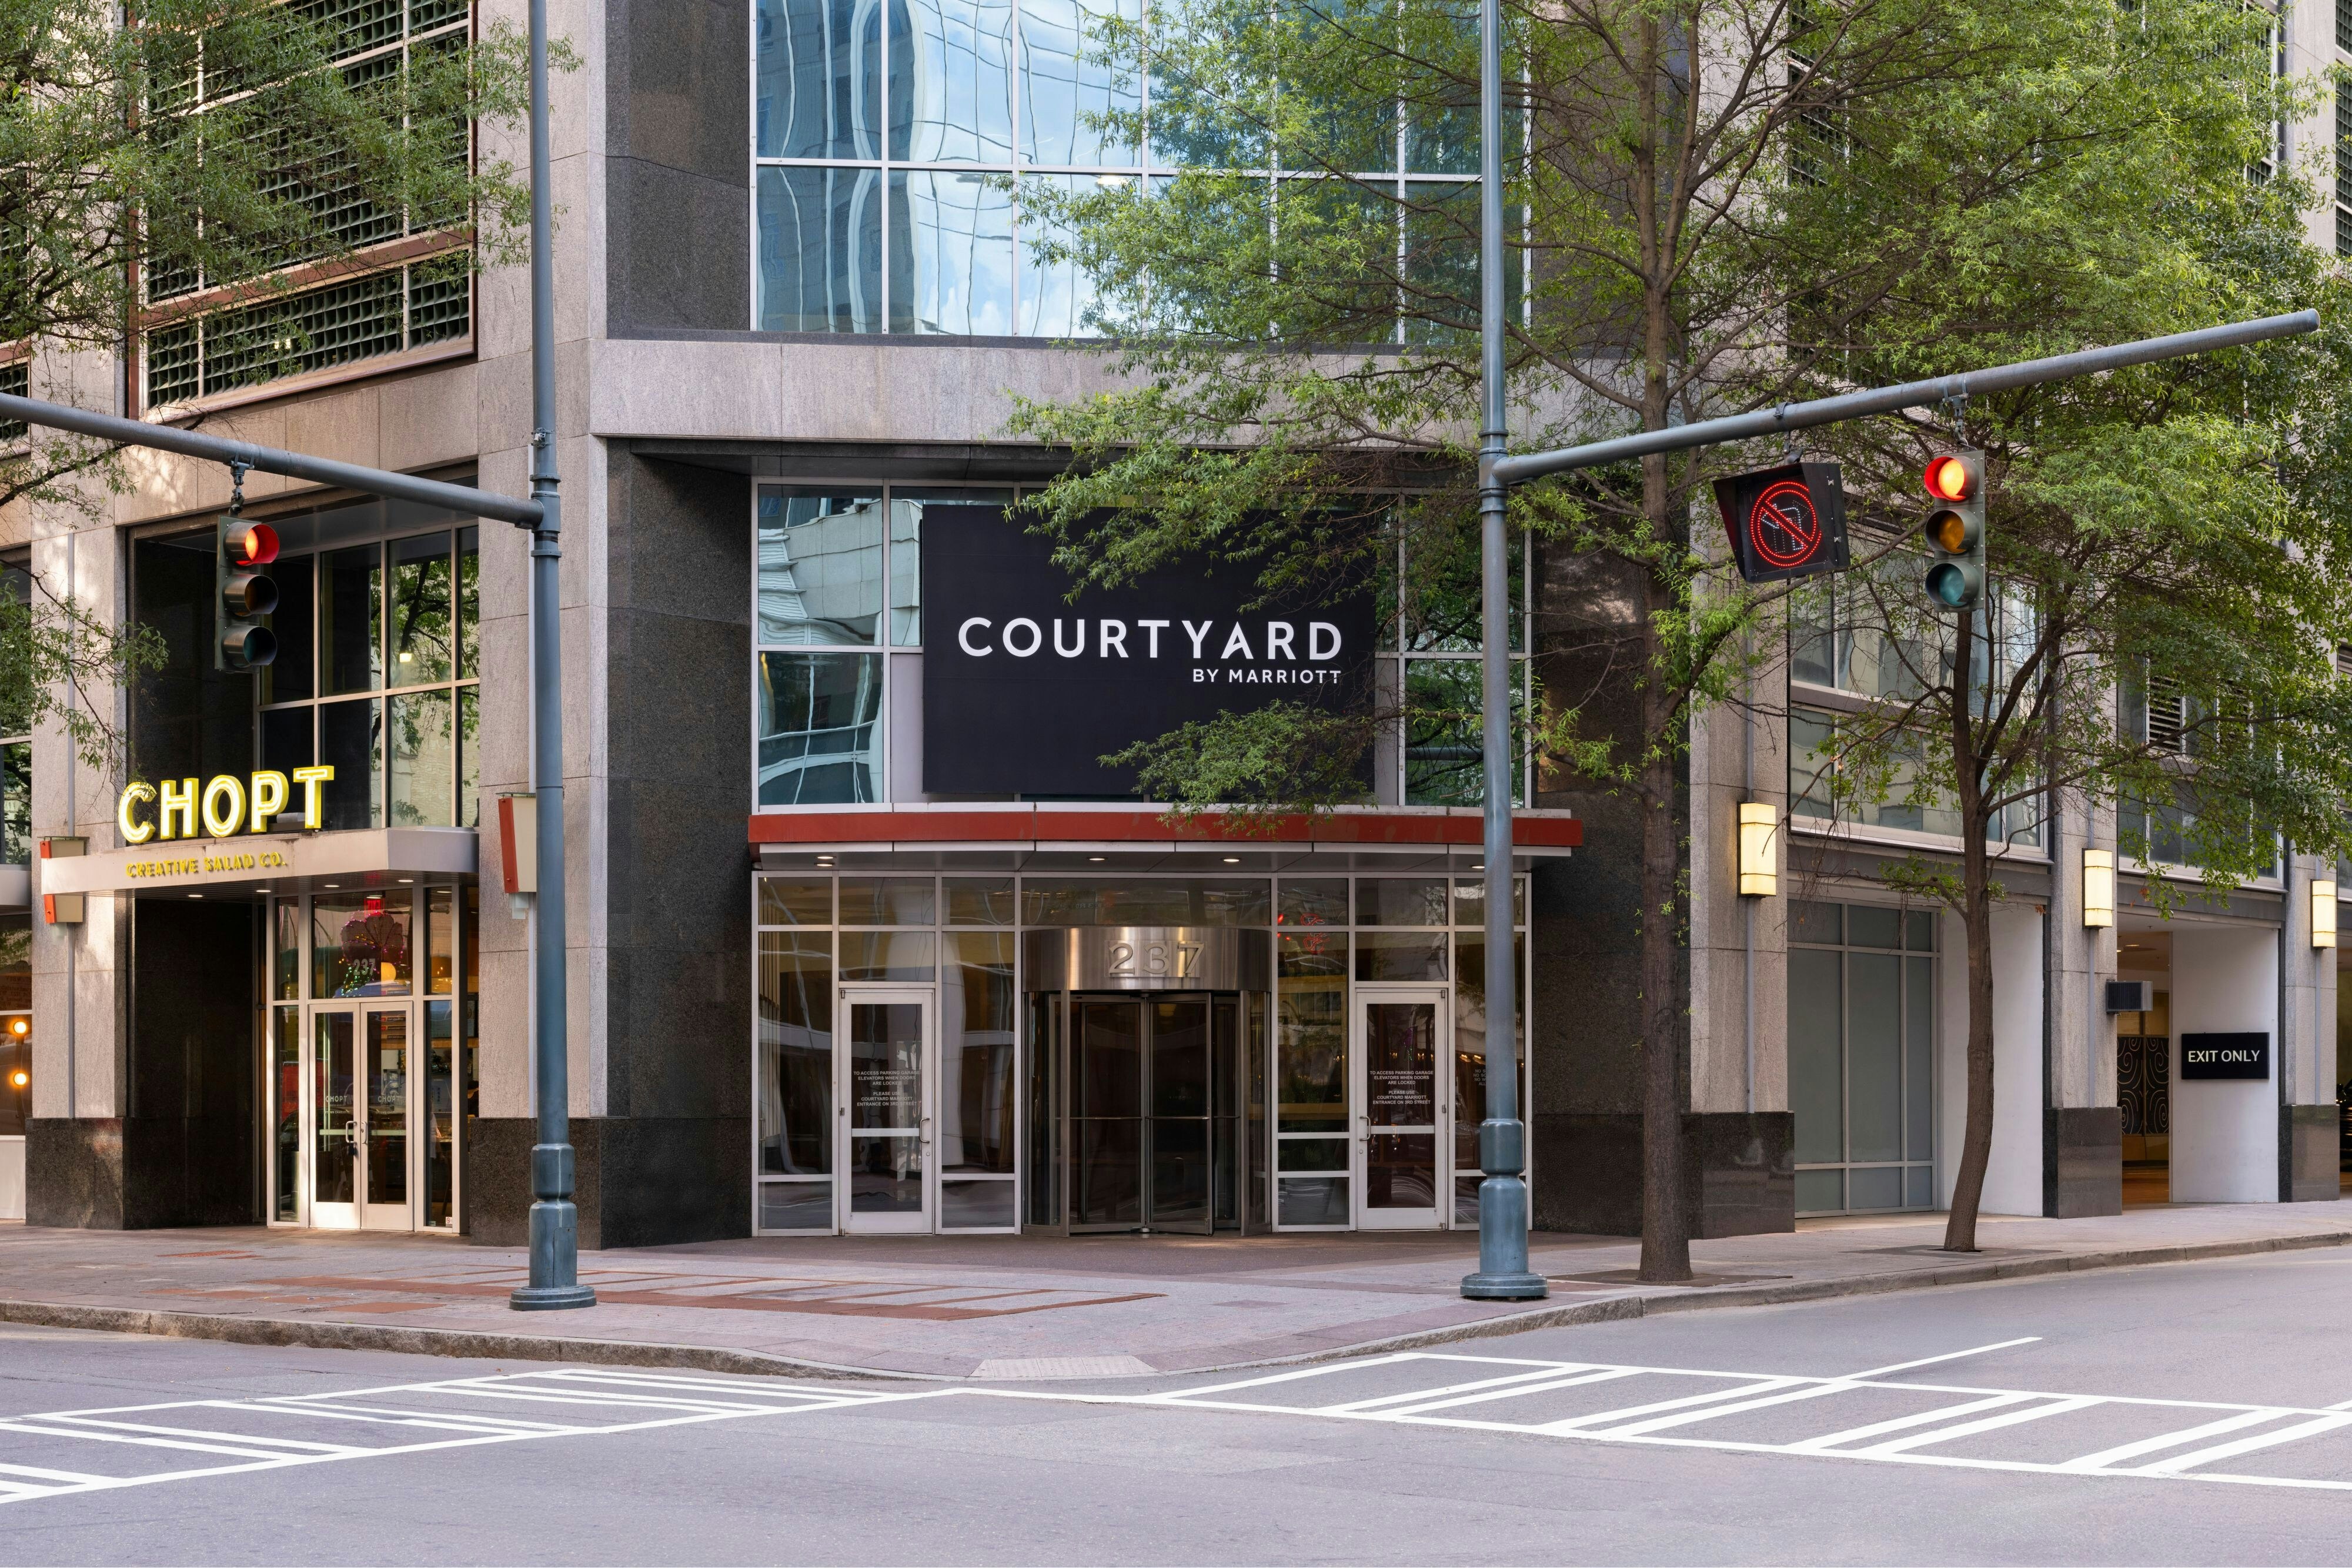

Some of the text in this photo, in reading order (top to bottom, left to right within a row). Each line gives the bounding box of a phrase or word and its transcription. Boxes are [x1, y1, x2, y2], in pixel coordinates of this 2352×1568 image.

[958, 617, 1341, 660] COURTYARD
[1193, 668, 1341, 684] BY MARRIOTT
[118, 765, 335, 844] CHOPT
[125, 851, 287, 878] CREATIVE SALAD CO.
[353, 958, 376, 976] 237
[1108, 942, 1204, 975] 237
[2188, 1050, 2260, 1062] EXIT ONLY
